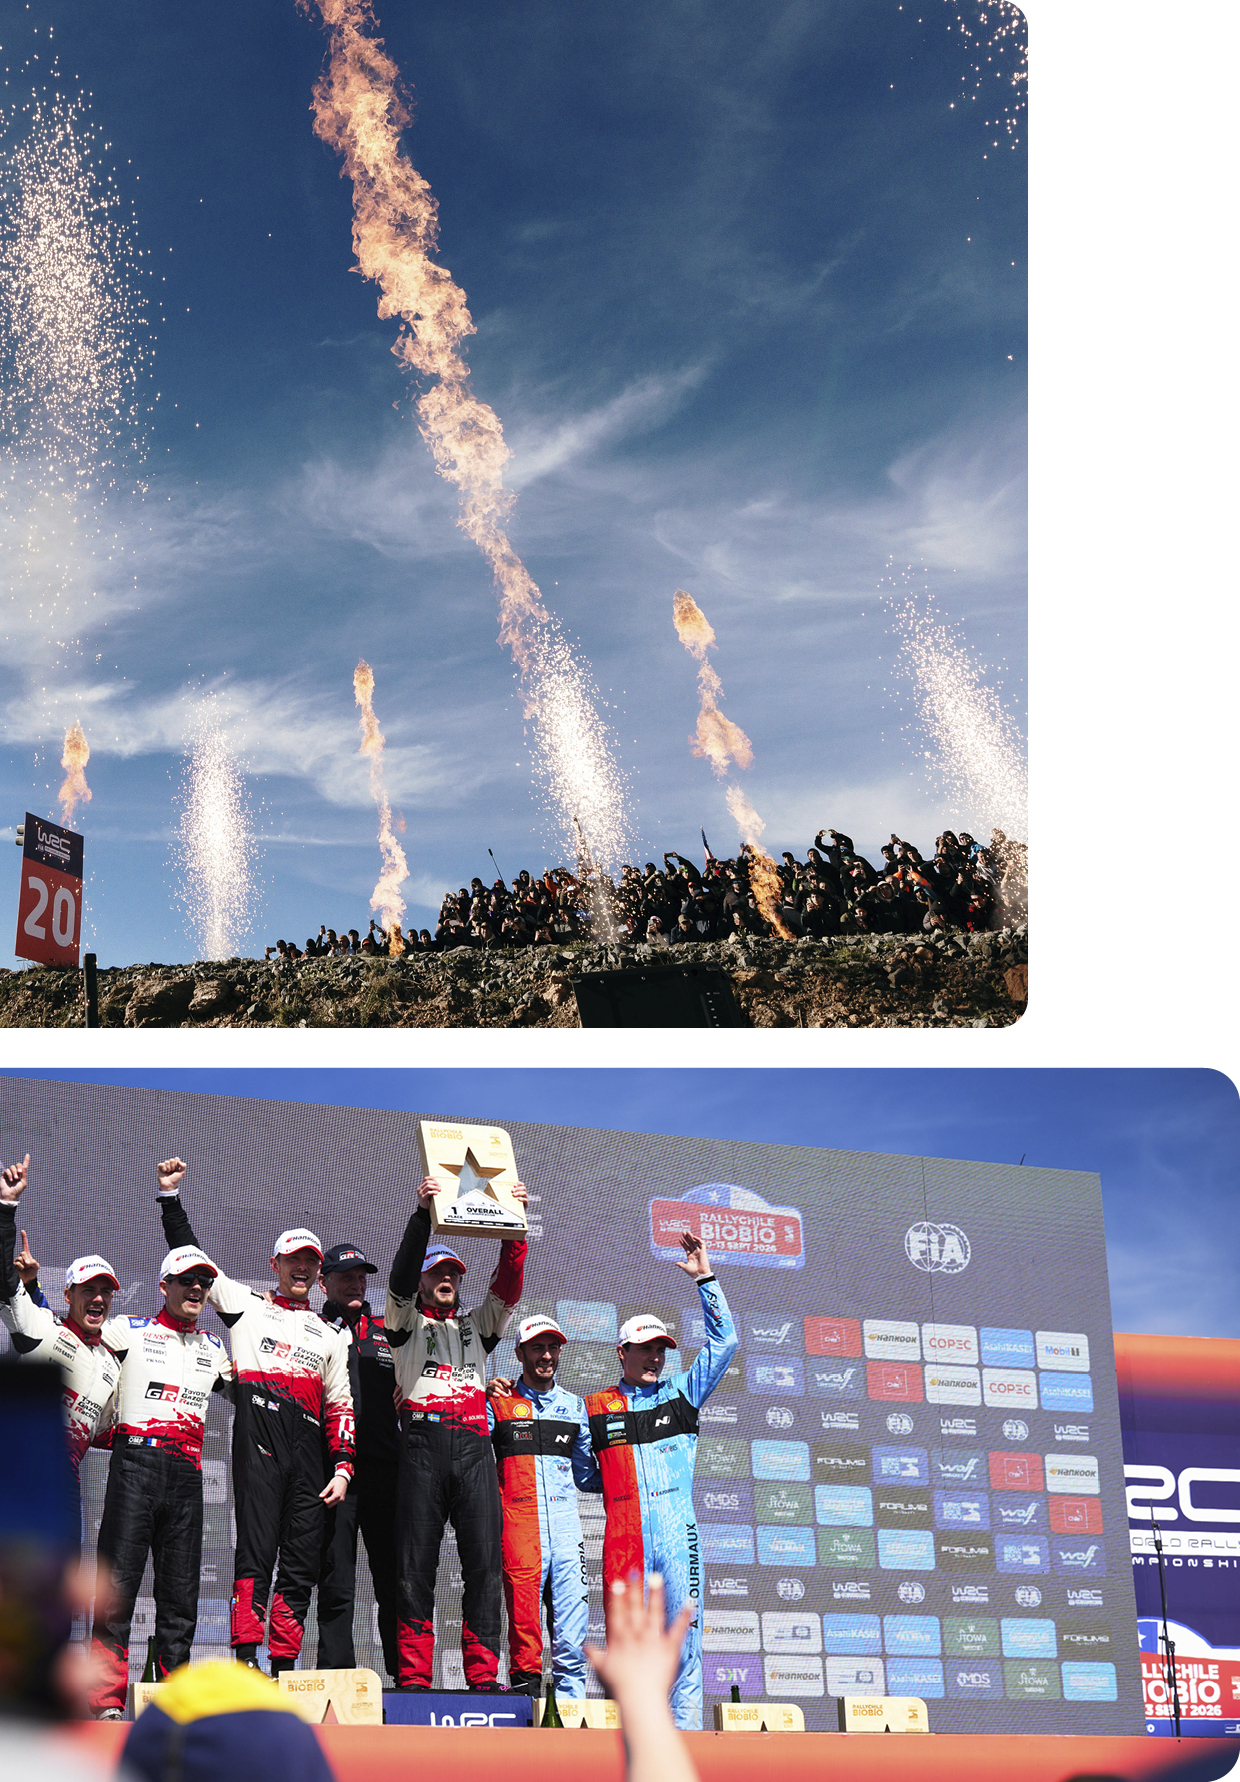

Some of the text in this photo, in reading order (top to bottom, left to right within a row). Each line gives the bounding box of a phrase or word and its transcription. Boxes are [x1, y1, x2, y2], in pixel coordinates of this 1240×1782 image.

[38, 827, 70, 853] WRC
[24, 876, 75, 947] 20
[451, 1206, 504, 1216] 1 OVERALL
[699, 1213, 775, 1227] RALLYCHILE
[753, 1244, 777, 1253] 2026
[142, 1332, 170, 1341] DENSO
[259, 1341, 290, 1359] GR
[929, 1337, 972, 1350] COPEC
[1045, 1345, 1071, 1356] Mobil
[422, 1366, 451, 1381] GR
[145, 1386, 179, 1402] GR
[989, 1382, 1031, 1395] COPEC
[821, 1411, 859, 1423] WRC
[940, 1418, 976, 1429] WRC
[1054, 1424, 1089, 1435] WRC
[1123, 1464, 1240, 1523] RC
[1132, 1536, 1240, 1549] ORLD RALL
[1132, 1556, 1238, 1568] MPIONSHI
[709, 1578, 748, 1589] WRC
[832, 1582, 871, 1593] WRC
[951, 1586, 989, 1596] WRC
[1066, 1589, 1103, 1600] WRC
[1141, 1663, 1219, 1680] LLYCHILE
[1142, 1678, 1221, 1704] IOBÍO
[1155, 1704, 1188, 1716] SET
[1190, 1705, 1223, 1716] 2026
